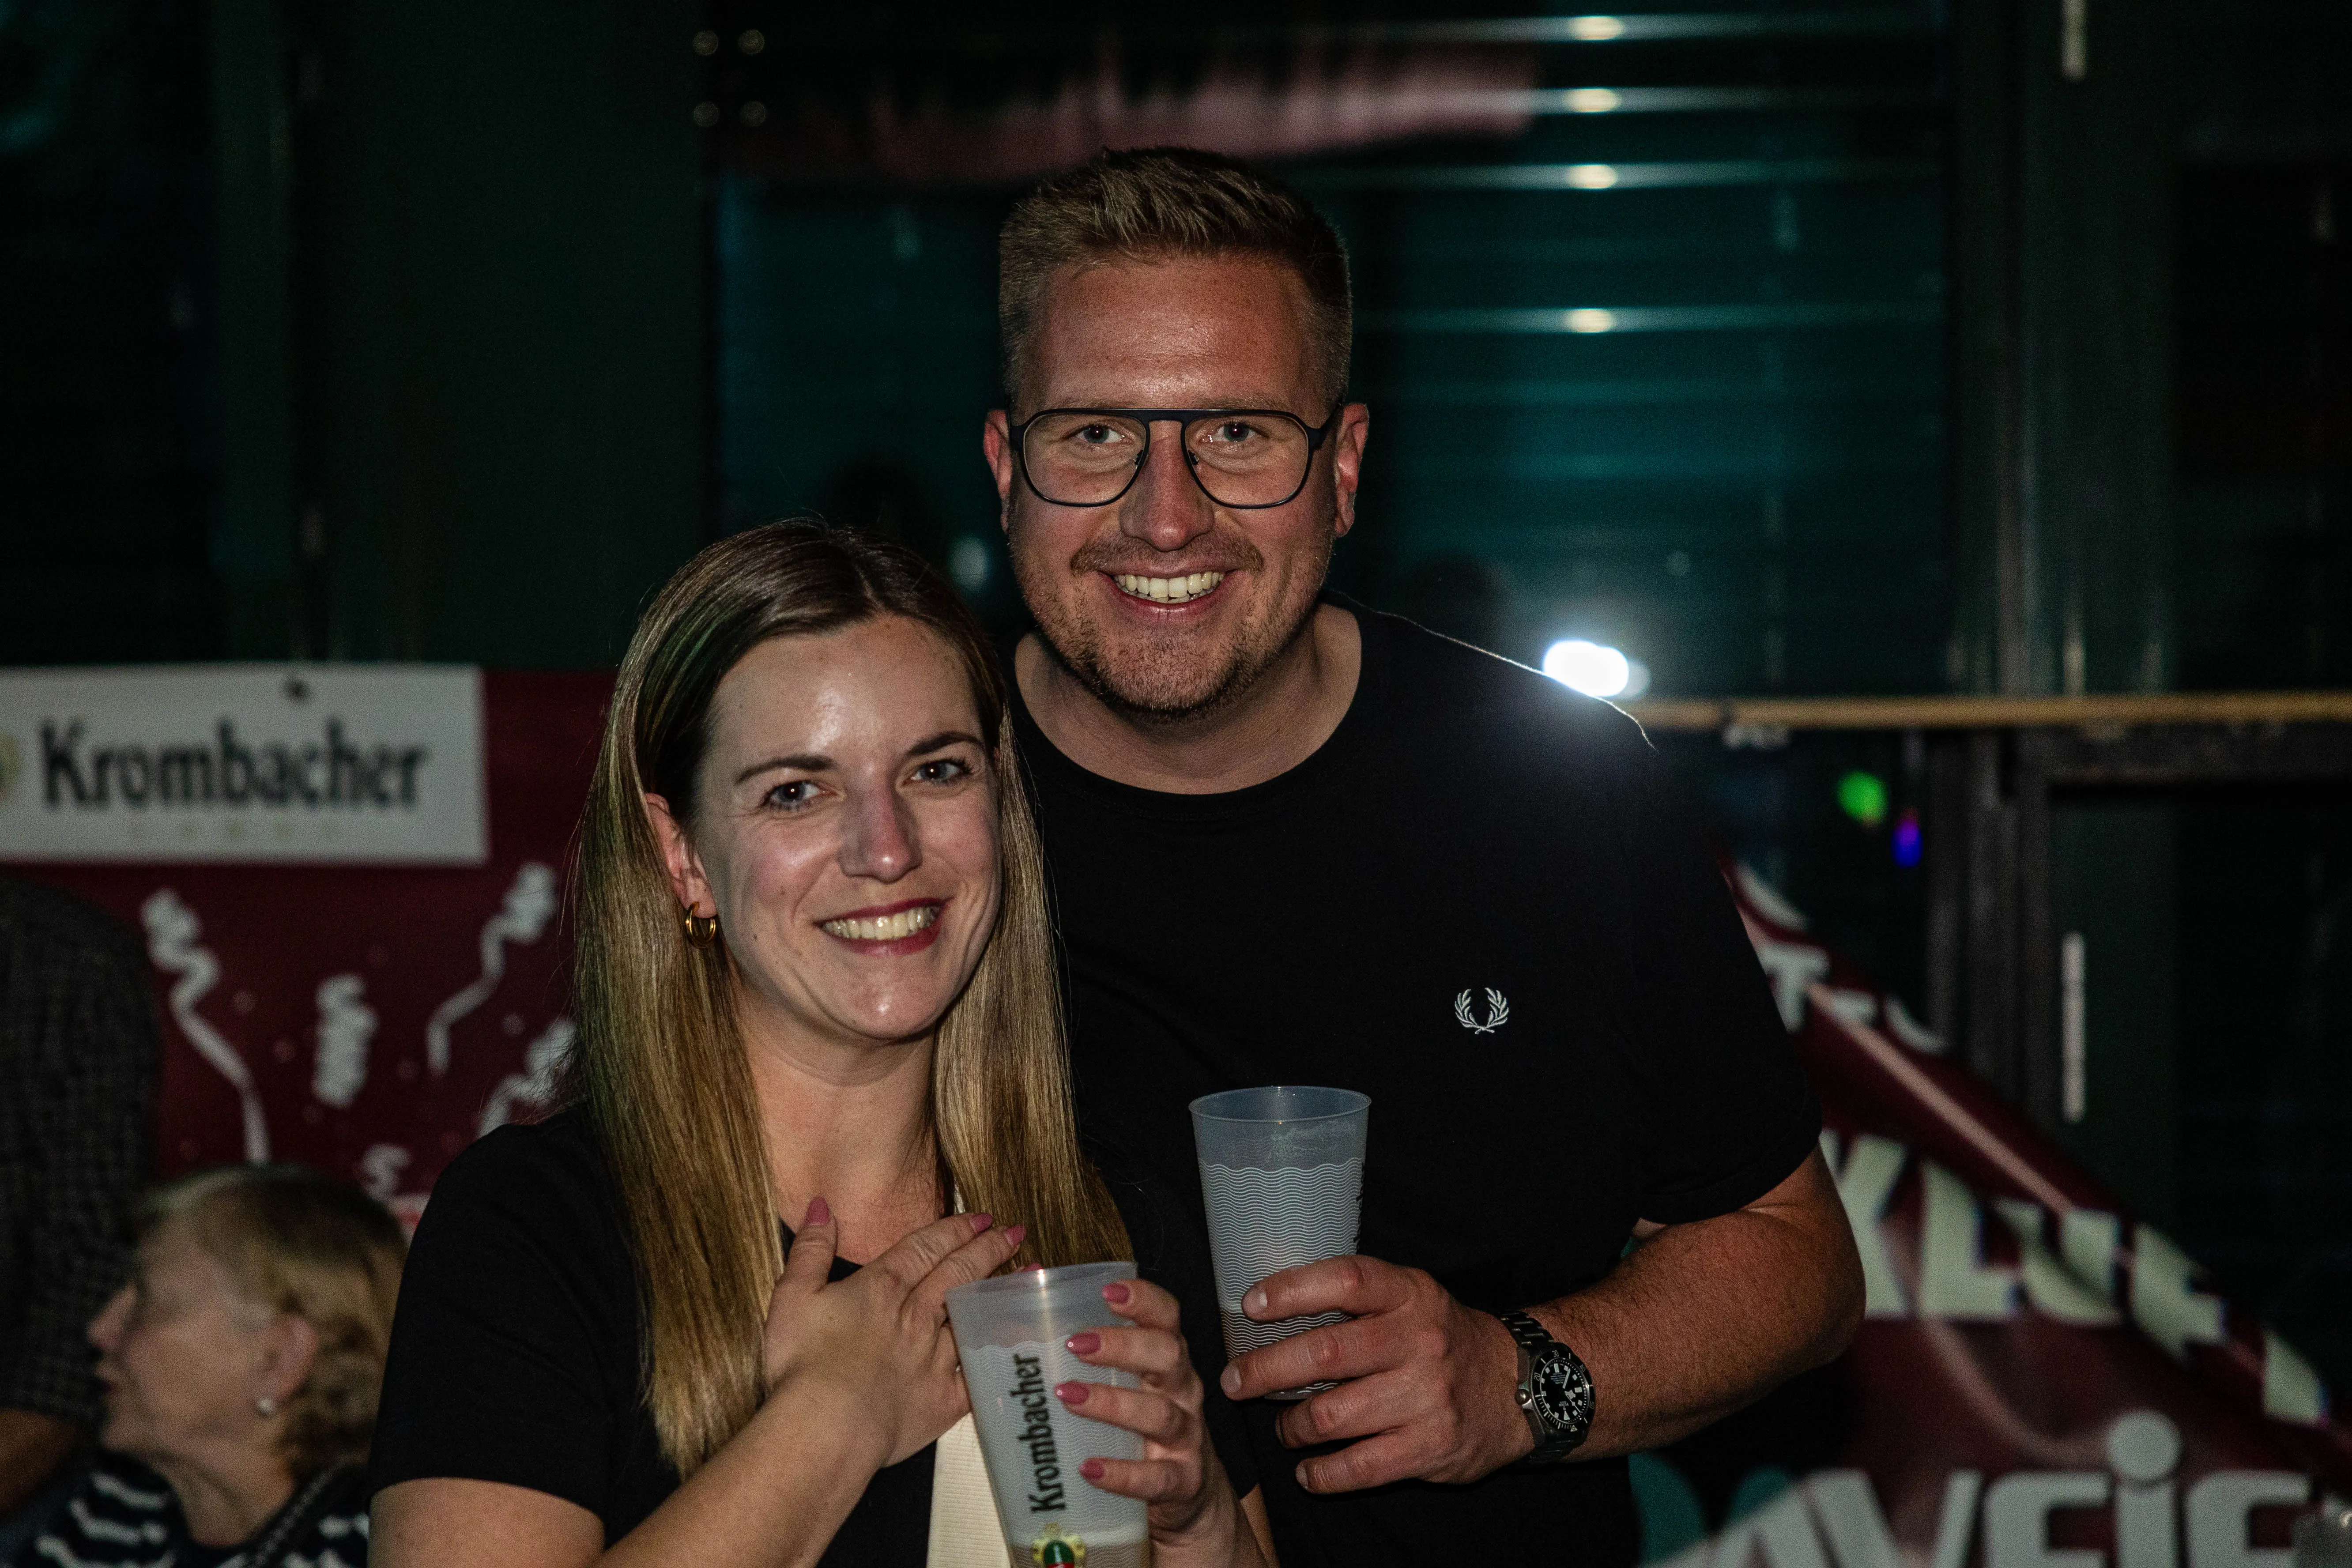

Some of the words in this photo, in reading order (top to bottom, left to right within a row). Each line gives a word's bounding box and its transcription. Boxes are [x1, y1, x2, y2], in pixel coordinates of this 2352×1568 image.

[41, 717, 426, 809] Krombacher
[1533, 1372, 1541, 1381] 20
[1010, 1353, 1066, 1513] Krombacher
